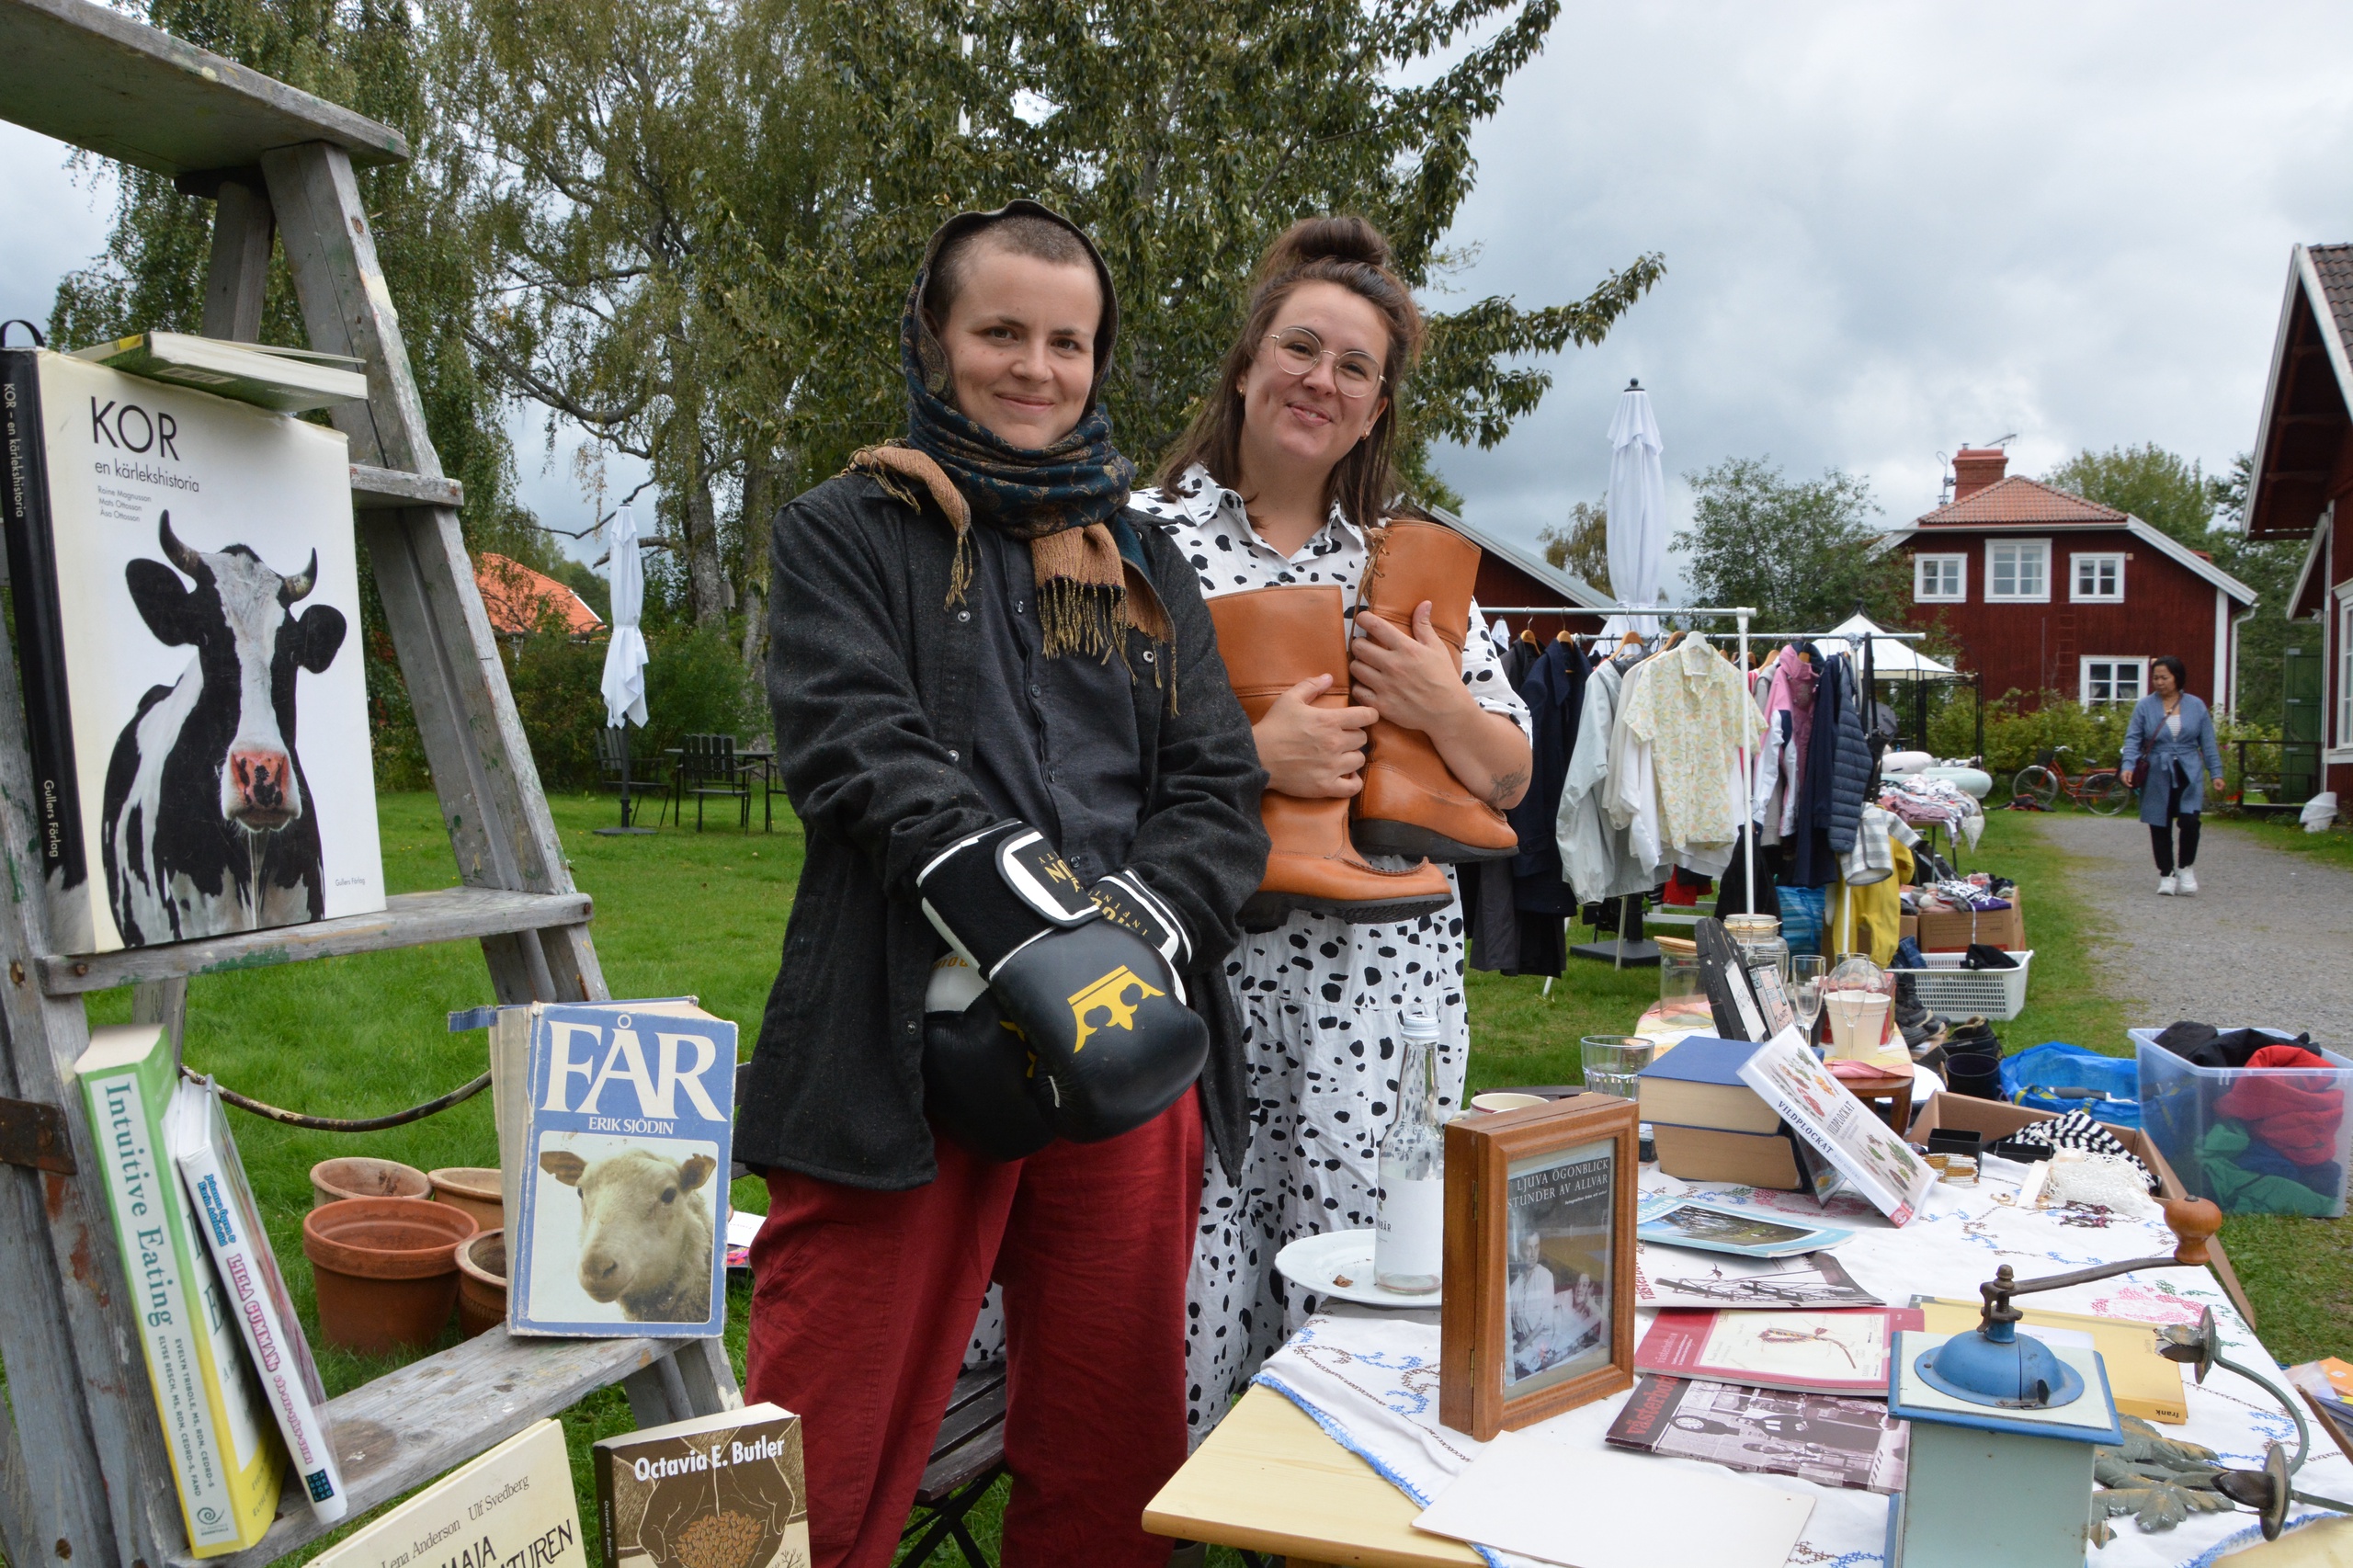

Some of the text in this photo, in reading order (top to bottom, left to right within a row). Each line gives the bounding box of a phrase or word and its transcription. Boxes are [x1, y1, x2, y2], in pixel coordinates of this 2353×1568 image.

[4, 382, 17, 408] KOR
[6, 421, 17, 436] en
[91, 395, 180, 461] KOR
[9, 438, 26, 518] kärlekshistoria
[95, 458, 199, 493] en kärlekshistoria
[99, 497, 142, 512] Mats Ottosson
[117, 490, 152, 502] Magnusson
[114, 511, 141, 522] Ottosson
[44, 779, 62, 858] Gullers Förlag
[540, 1014, 729, 1122] FÅR
[588, 1117, 674, 1135] ERIK SJÖDIN
[1778, 1100, 1834, 1154] VILDPLOCKAT
[1826, 1100, 1856, 1136] VILDPLOCKAT
[204, 1174, 223, 1210] Johanna
[1507, 1174, 1608, 1210] STUNDER AV ALLVAR
[1517, 1159, 1608, 1193] LJUVA ÖGONBLICK
[105, 1082, 174, 1328] Intuitive Eating
[198, 1181, 211, 1208] Karin
[226, 1253, 256, 1301] LILLA
[158, 1335, 170, 1361] ELYSE
[164, 1362, 176, 1394] RESCH,
[175, 1338, 188, 1371] EVELYN
[183, 1372, 198, 1412] TRIBOLE,
[192, 1412, 200, 1427] MS,
[196, 1428, 205, 1449] RDN,
[172, 1394, 181, 1410] MS,
[2155, 1409, 2179, 1419] frank
[176, 1410, 186, 1432] RDN,
[634, 1435, 785, 1482] Octavia E. Butler
[190, 1474, 201, 1497] FAND
[381, 1475, 530, 1568] Lena Anderson Ulf Svedberg
